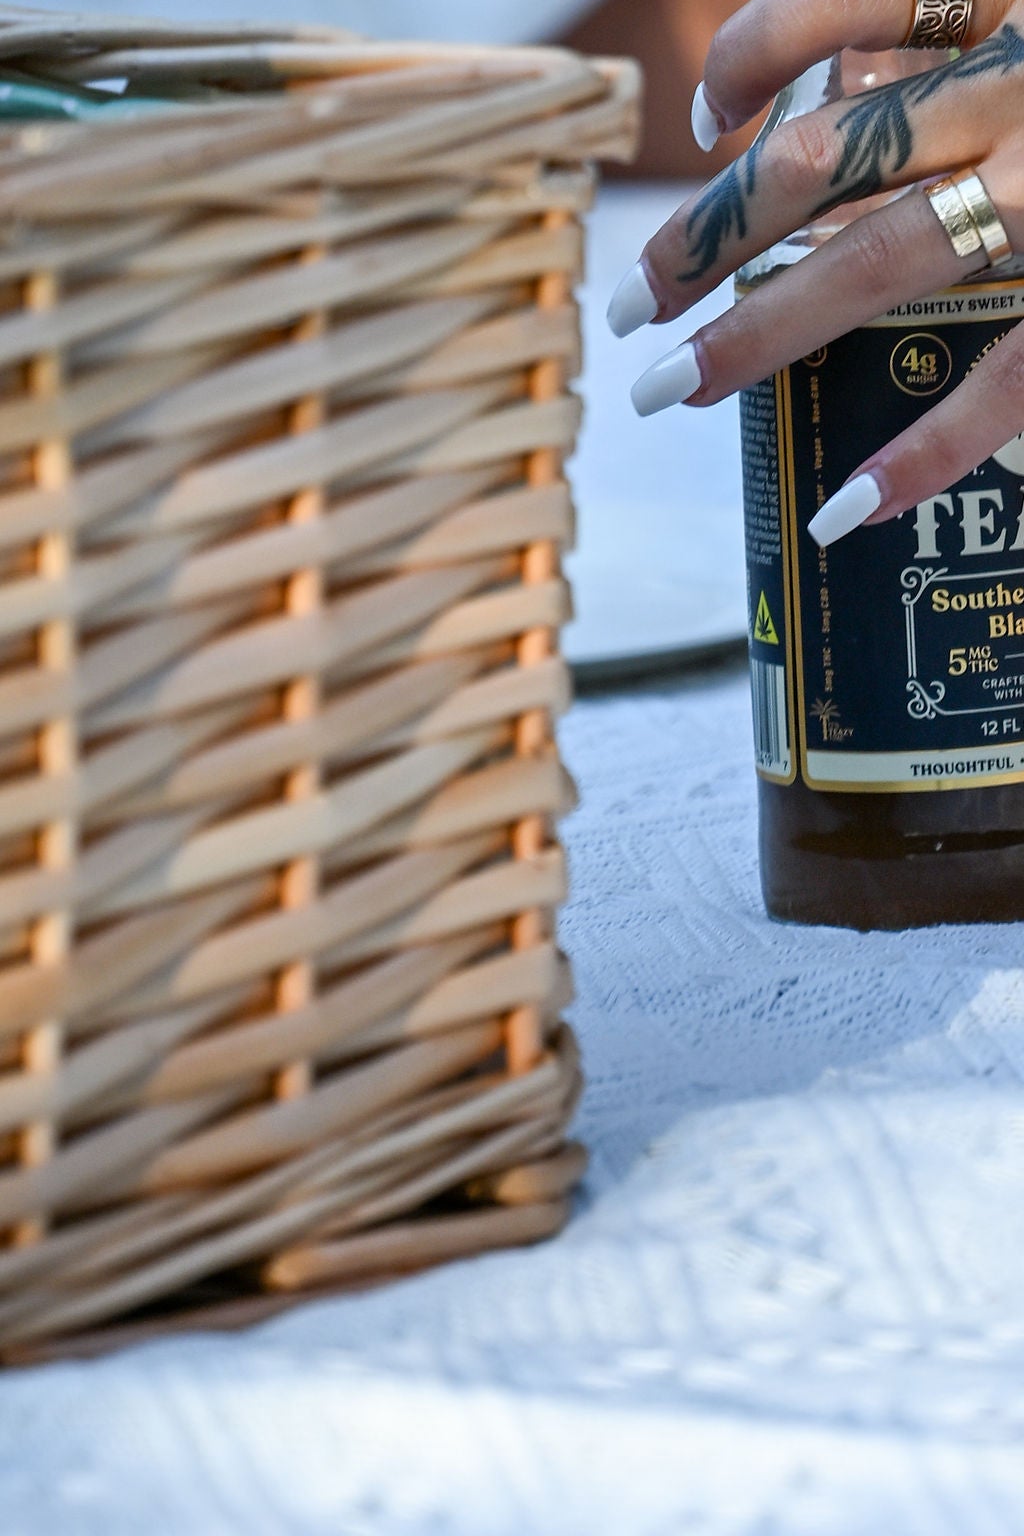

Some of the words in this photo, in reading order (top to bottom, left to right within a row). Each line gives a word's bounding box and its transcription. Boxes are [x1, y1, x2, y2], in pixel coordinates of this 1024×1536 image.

[968, 294, 1016, 312] SWEET
[901, 347, 937, 376] 4g
[906, 373, 939, 384] sugar
[814, 437, 823, 470] Vegan
[949, 648, 968, 676] 5
[969, 646, 991, 660] MG
[969, 658, 1000, 674] THC
[994, 685, 1023, 701] WITH
[981, 720, 999, 737] 12
[1003, 718, 1020, 734] FL
[910, 756, 1014, 777] THOUGHTFUL
